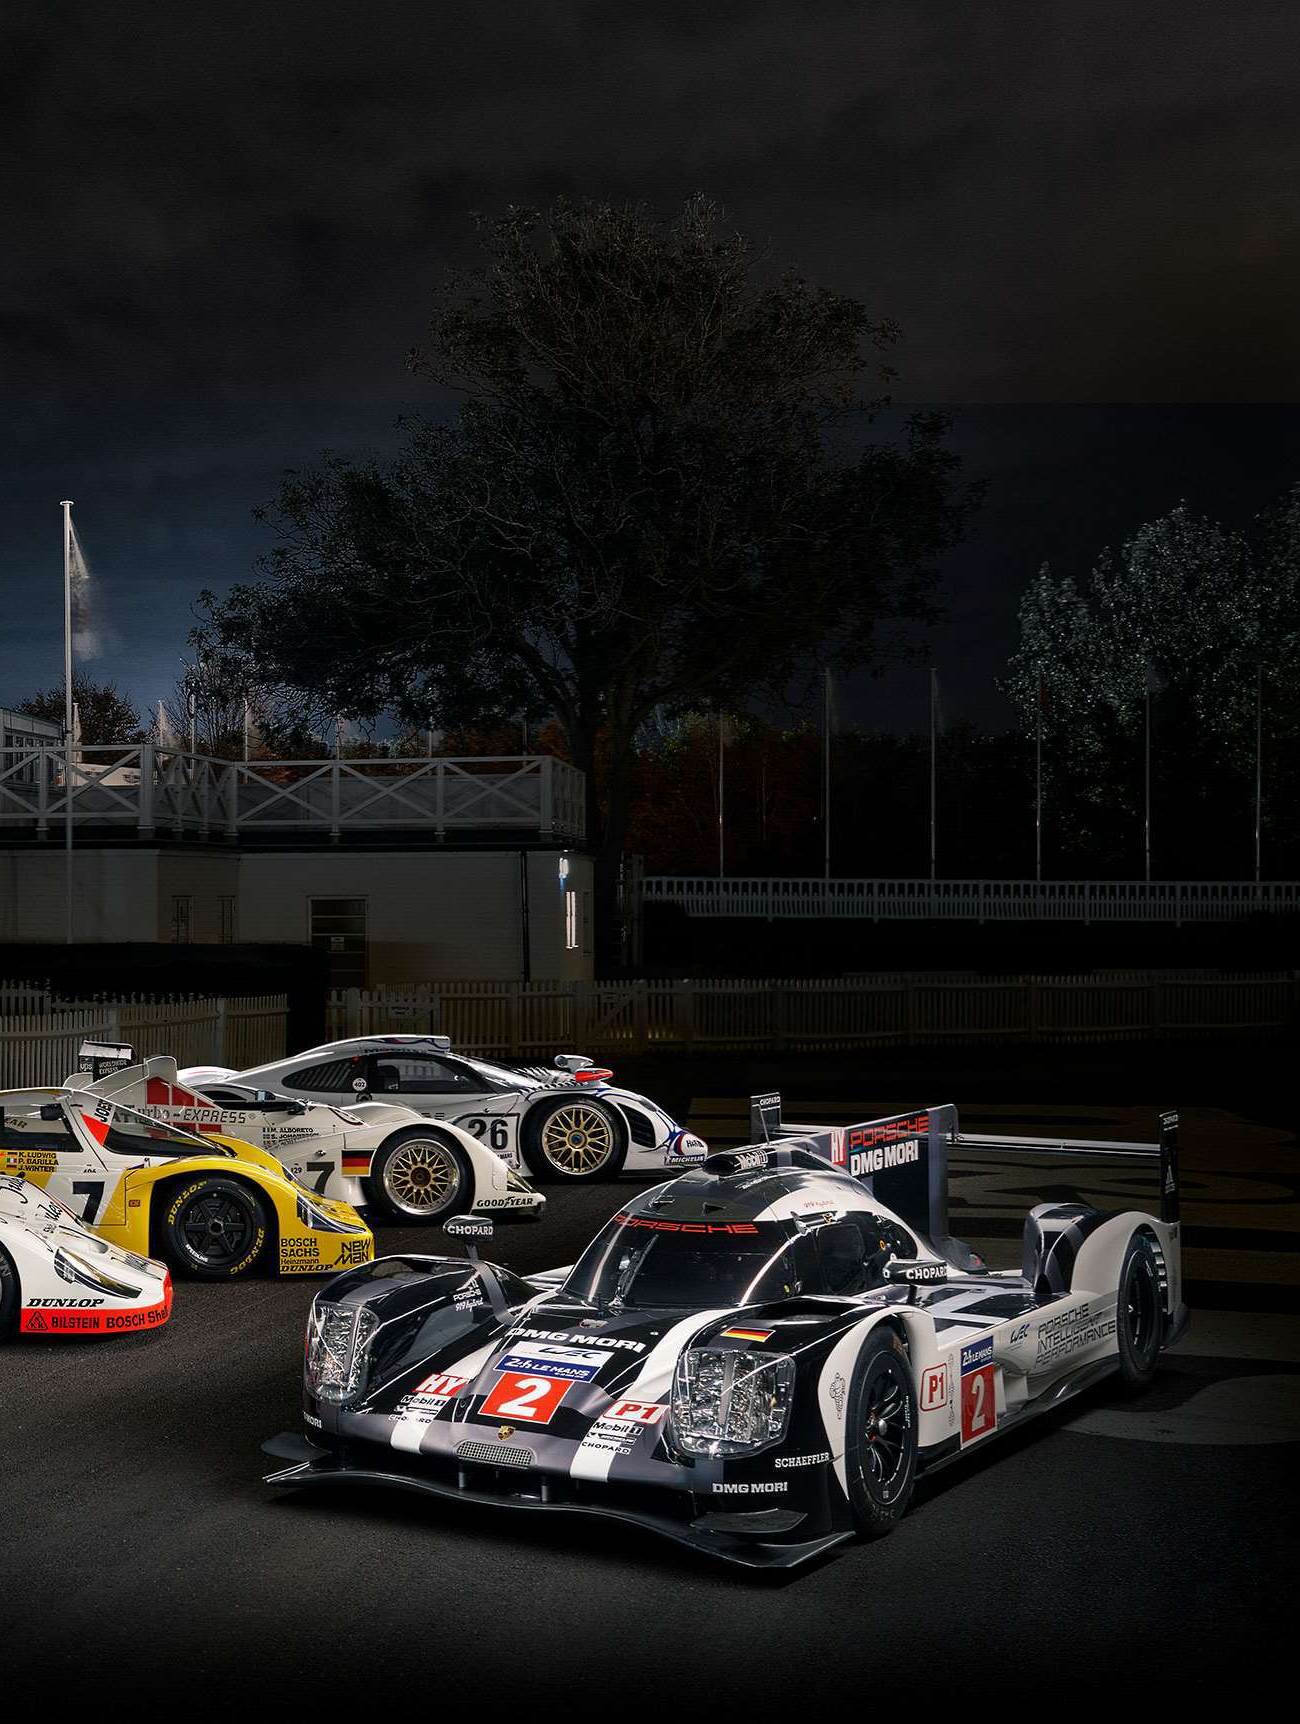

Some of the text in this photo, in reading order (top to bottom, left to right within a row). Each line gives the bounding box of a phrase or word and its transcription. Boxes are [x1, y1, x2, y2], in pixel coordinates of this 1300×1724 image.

[183, 1109, 246, 1123] EXPRESS
[468, 1118, 509, 1150] 26
[850, 1116, 929, 1149] PORSCHE
[831, 1131, 845, 1163] HY
[851, 1140, 919, 1177] DMG MORI
[307, 1161, 335, 1194] 7
[73, 1181, 105, 1225] 7
[447, 1224, 493, 1236] CHOPARD
[614, 1214, 758, 1234] PORSCHE
[280, 1238, 317, 1247] BOSCH
[280, 1248, 320, 1257] SACHS
[280, 1264, 333, 1272] DUNLOP
[906, 1264, 947, 1280] CHOPARD
[26, 1298, 104, 1307] DUNLOP
[51, 1316, 100, 1328] BILSTEIN
[106, 1314, 145, 1328] BOSCH
[1038, 1303, 1089, 1339] PORSCHE
[505, 1327, 646, 1353] DMG MORI
[550, 1366, 590, 1377] MANS
[415, 1374, 469, 1395] HY
[928, 1372, 944, 1403] P1
[401, 1395, 434, 1406] Mobil
[497, 1377, 552, 1417] 2
[972, 1374, 986, 1432] 2
[389, 1414, 432, 1424] CHORD
[615, 1403, 659, 1420] P1
[593, 1421, 629, 1433] Mobil
[581, 1441, 630, 1454] CHOPARD
[775, 1452, 830, 1468] SCHAEFFLER
[712, 1482, 788, 1493] DMG MORI
